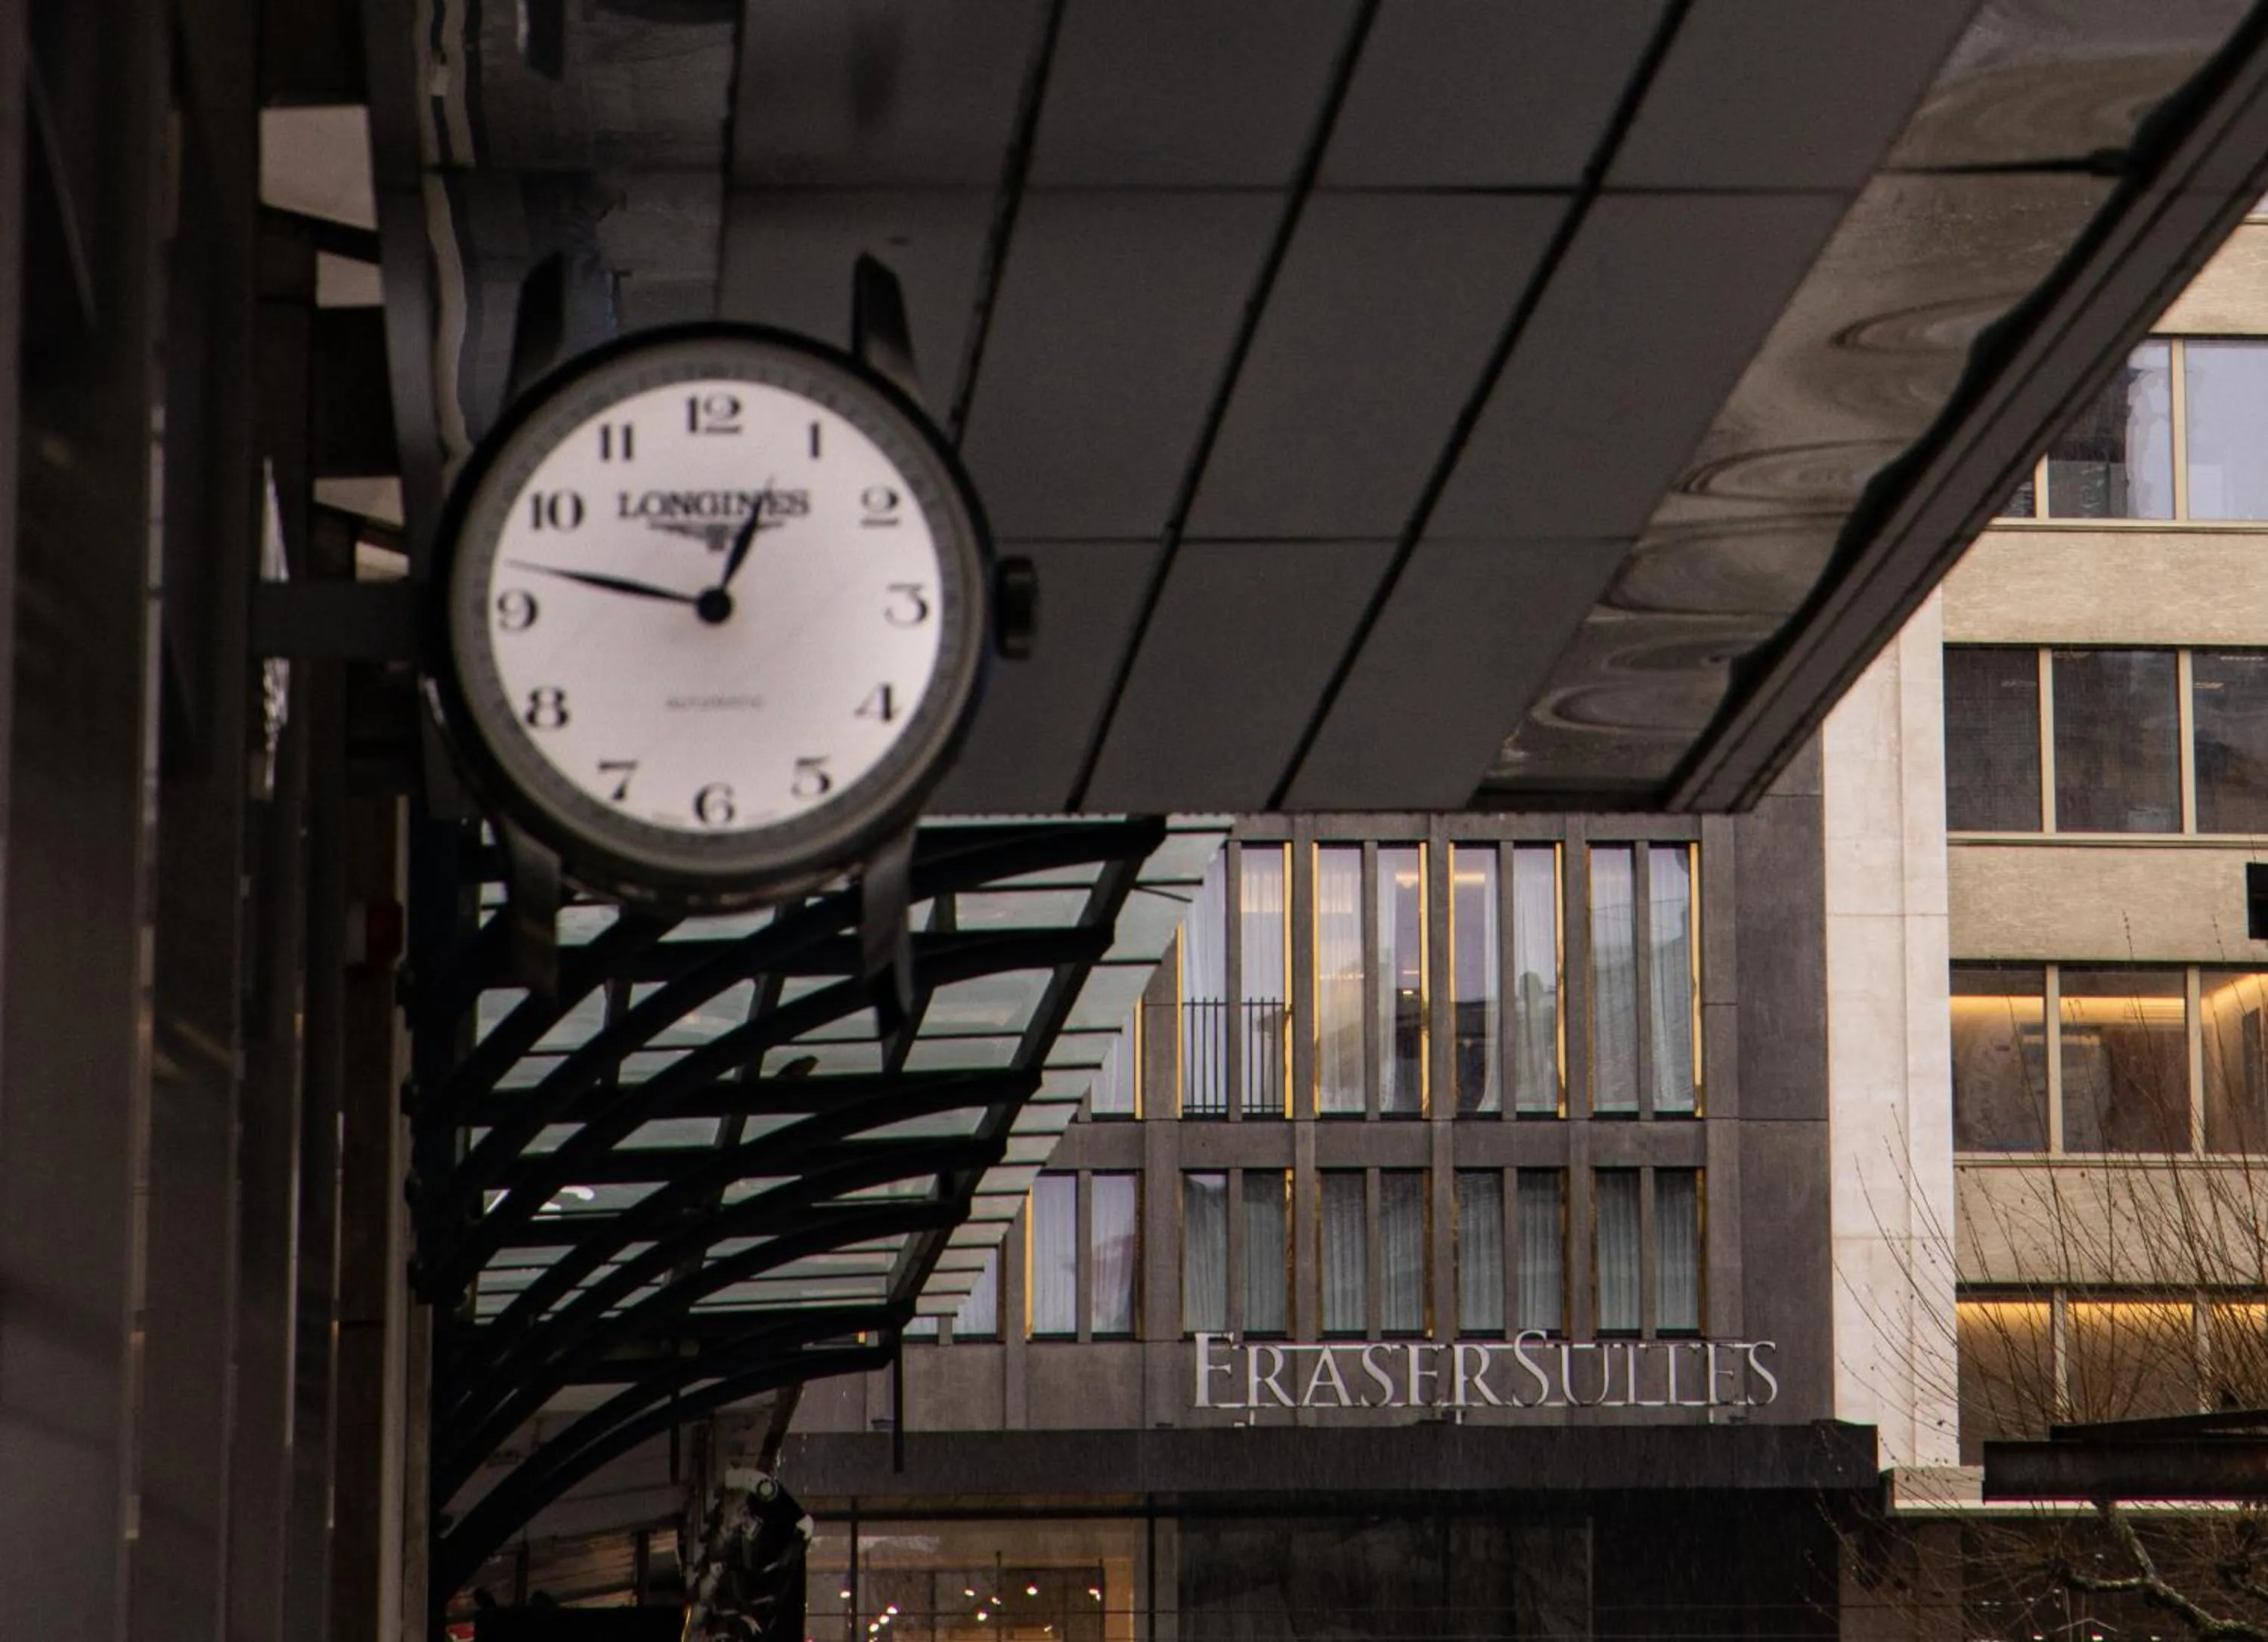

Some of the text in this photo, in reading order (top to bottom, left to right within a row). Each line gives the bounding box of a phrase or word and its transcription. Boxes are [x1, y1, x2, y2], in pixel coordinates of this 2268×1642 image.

[686, 395, 742, 435] 12
[599, 422, 634, 461] 11
[807, 420, 823, 460] 1
[529, 491, 585, 532] 10
[617, 489, 810, 518] LONGINES
[860, 486, 900, 527] 2
[496, 590, 538, 631] 9
[884, 583, 929, 627] 3
[525, 686, 570, 730] 8
[855, 683, 900, 723] 4
[597, 760, 637, 801] 7
[792, 757, 831, 800] 5
[694, 782, 736, 825] 6
